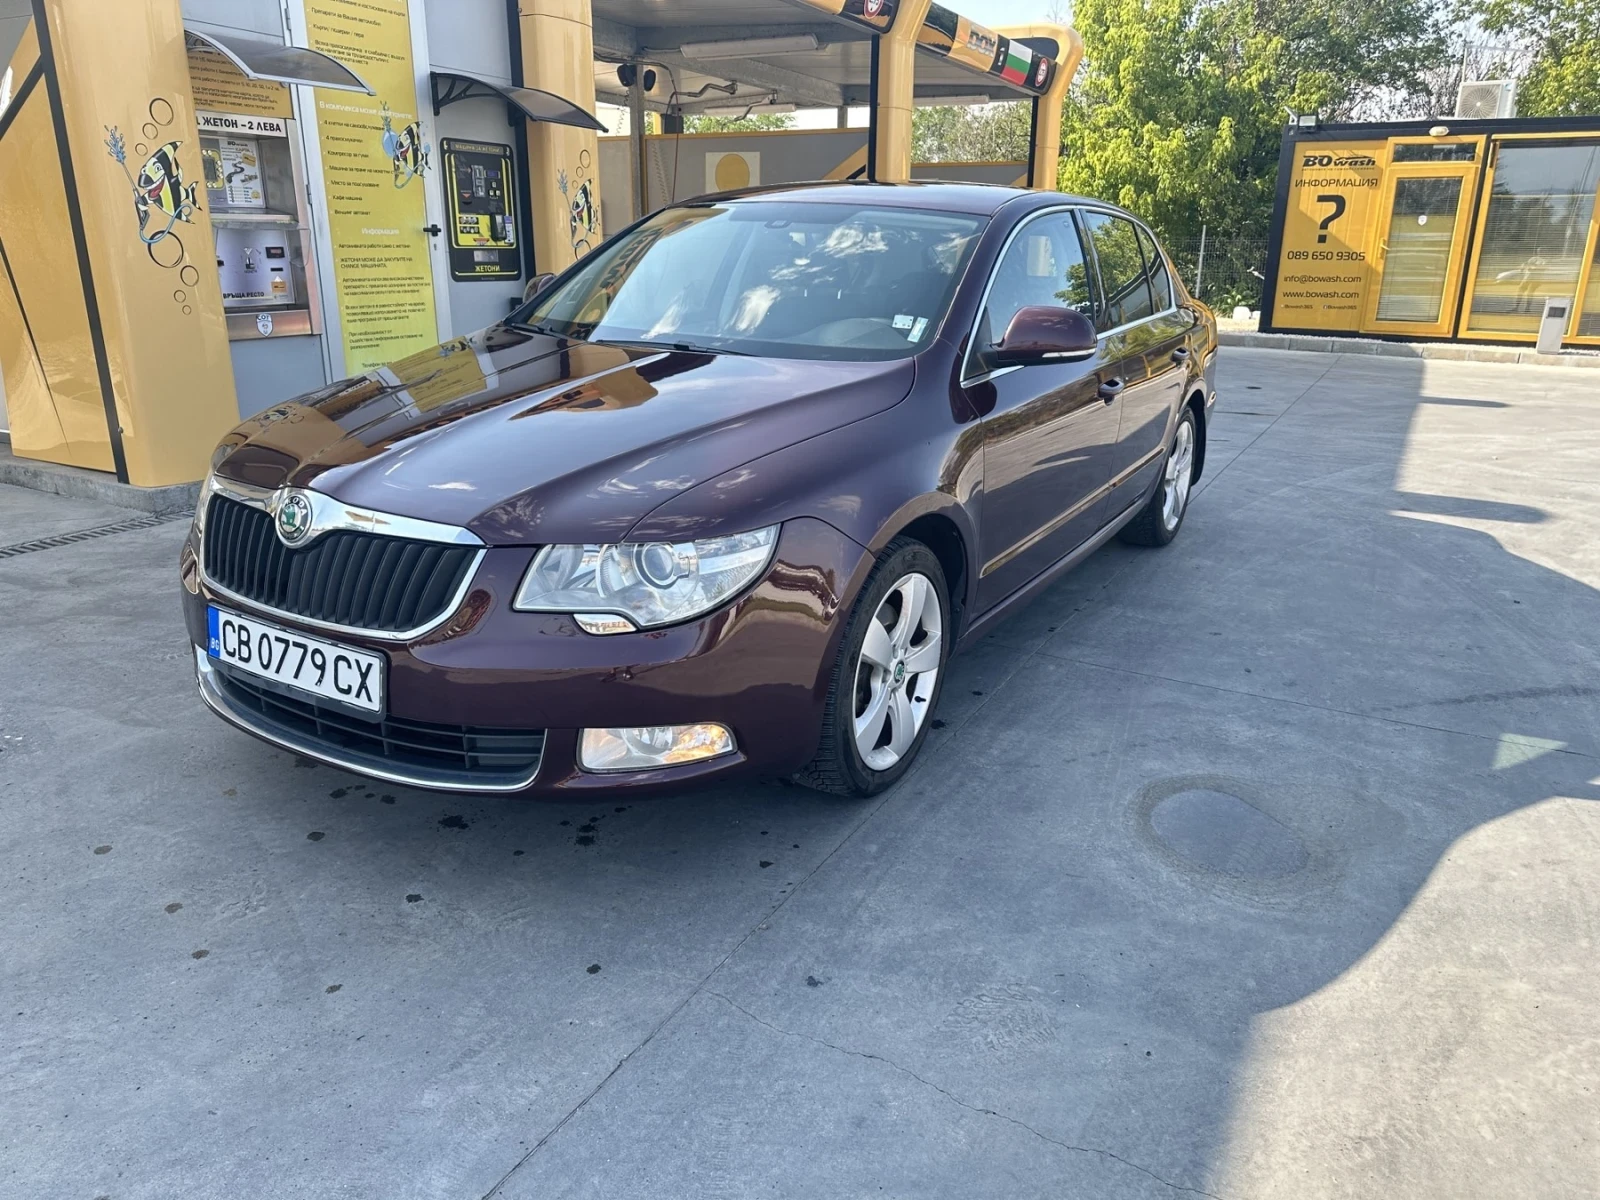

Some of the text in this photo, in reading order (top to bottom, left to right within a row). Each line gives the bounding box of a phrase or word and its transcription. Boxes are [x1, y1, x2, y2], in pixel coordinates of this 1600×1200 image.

[320, 100, 325, 108] В
[202, 116, 238, 128] ЖЕТОН
[248, 121, 254, 130] 2
[256, 122, 282, 132] ЛЕВА
[1295, 178, 1378, 188] ИНФОРМАЦИЯ
[1287, 250, 1366, 262] 089 650 9305
[1284, 274, 1362, 284] info@bowash.com
[1282, 290, 1360, 298] www.bowash.com
[211, 637, 220, 650] BG
[222, 619, 373, 702] CB 0779 CX
